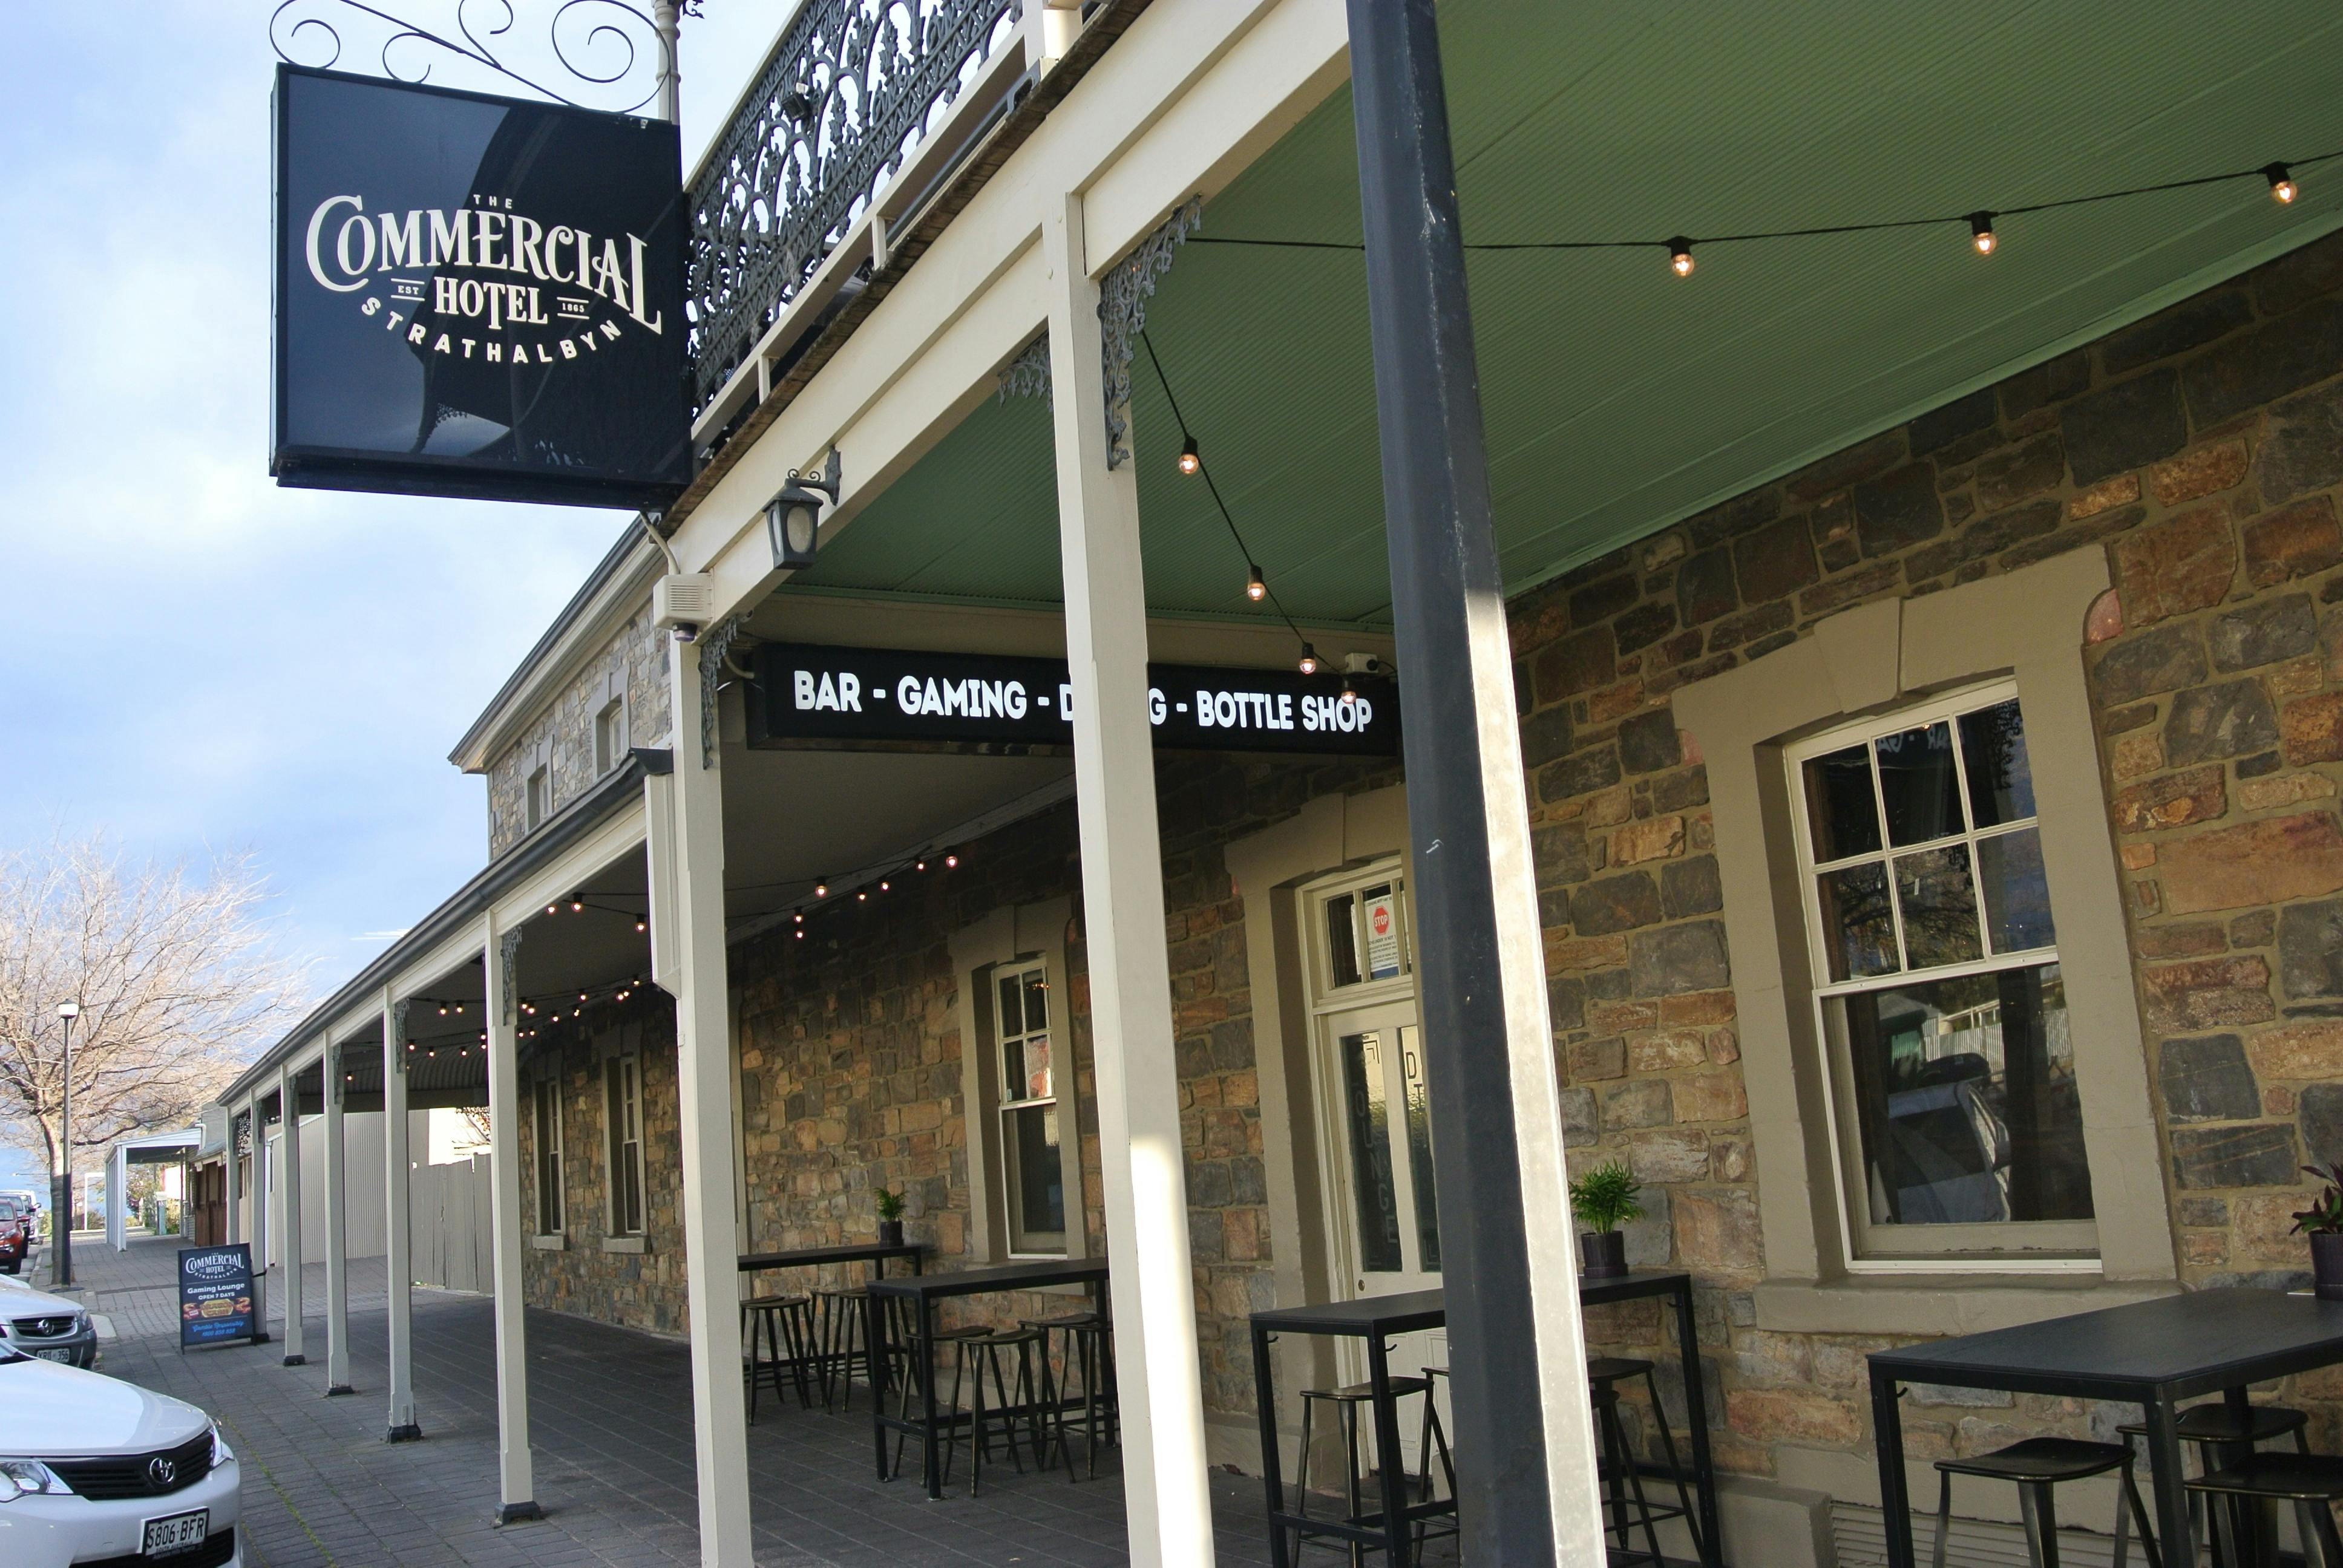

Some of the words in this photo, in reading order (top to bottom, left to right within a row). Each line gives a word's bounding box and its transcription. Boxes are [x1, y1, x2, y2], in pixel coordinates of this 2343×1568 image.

[473, 194, 513, 209] THE
[306, 195, 661, 335] COMMERCIAL
[398, 284, 419, 295] EST
[434, 276, 548, 330] HOTEL
[562, 302, 585, 313] 1865
[361, 296, 621, 364] STRATHALBYN
[794, 670, 862, 713] BAR
[897, 675, 1027, 720] GAMING
[1196, 690, 1294, 731] BOTTLE
[1301, 694, 1372, 733] SHOP
[1374, 914, 1389, 927] STOP
[185, 1253, 244, 1274] COMMERCIAL
[206, 1266, 225, 1275] HOTEL
